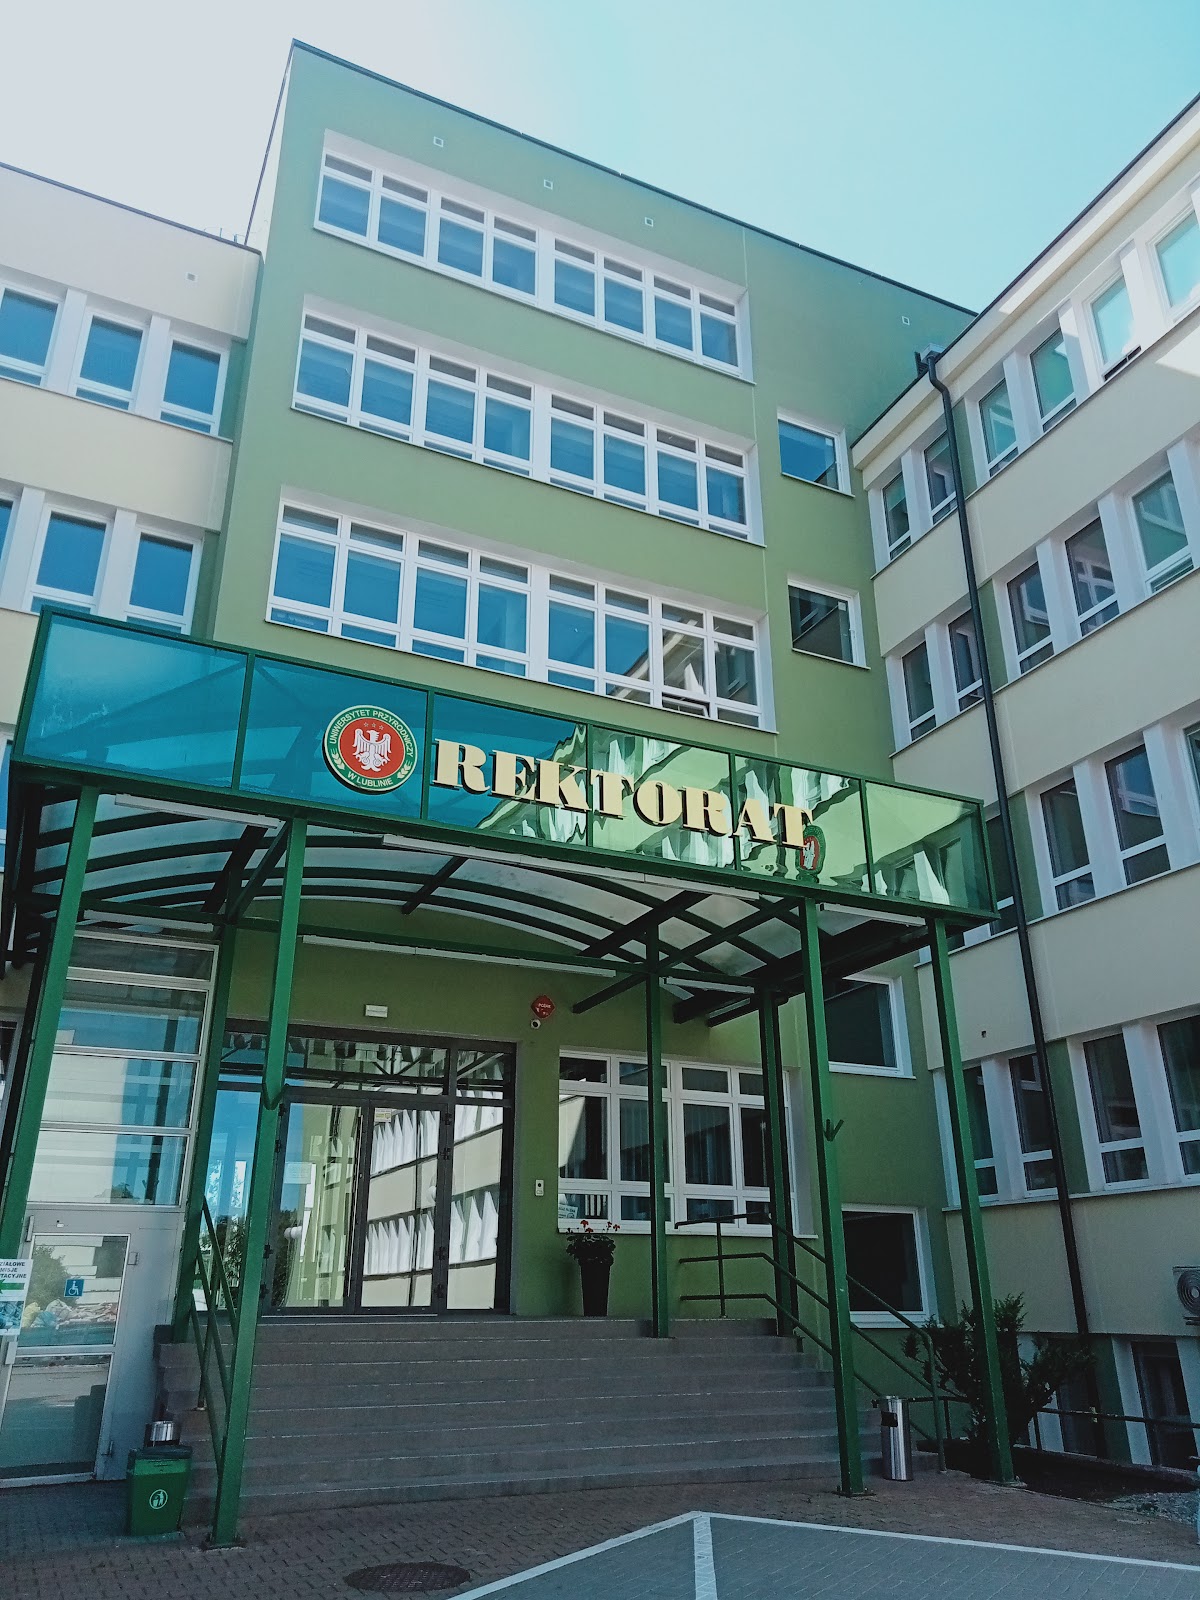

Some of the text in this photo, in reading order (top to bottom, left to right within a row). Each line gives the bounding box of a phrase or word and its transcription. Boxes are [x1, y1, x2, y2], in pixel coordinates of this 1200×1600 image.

[330, 709, 414, 757] UNIWERSYTET PRZYRODNICZY
[347, 771, 394, 787] W LUBLINIE
[431, 738, 813, 849] REKTORAT
